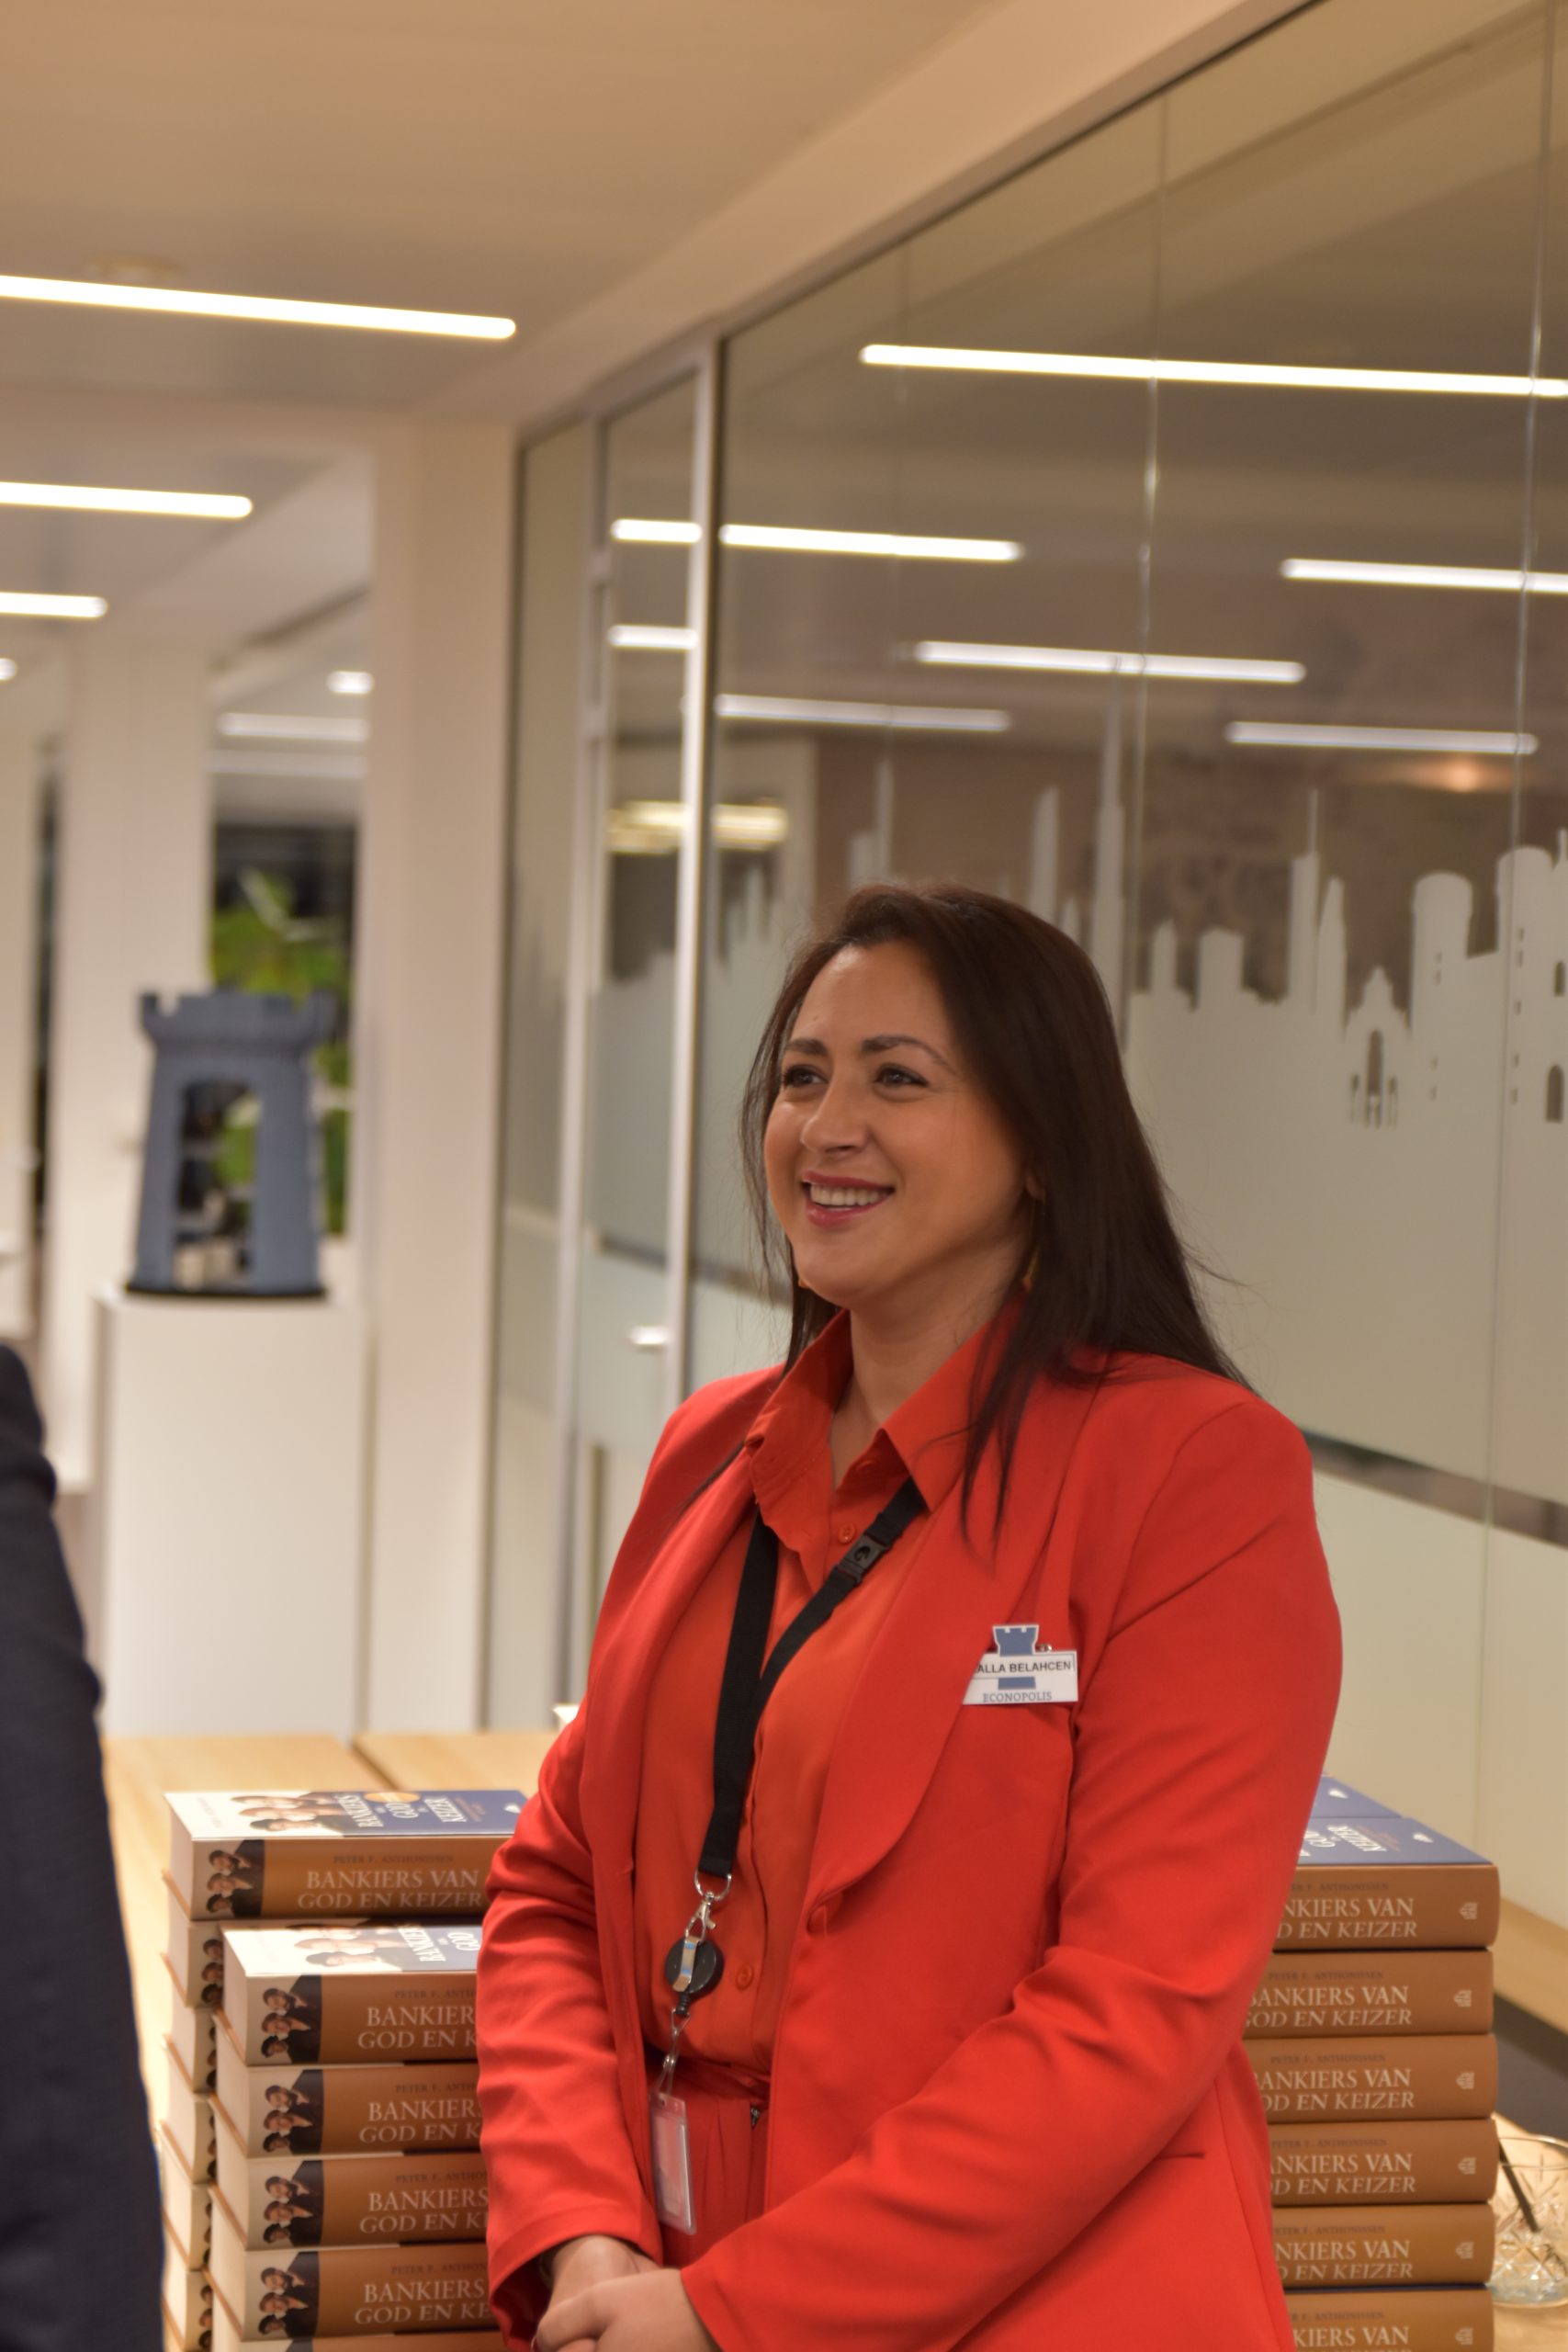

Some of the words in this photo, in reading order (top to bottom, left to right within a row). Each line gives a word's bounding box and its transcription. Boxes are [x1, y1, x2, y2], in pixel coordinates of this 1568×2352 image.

[1009, 1661, 1071, 1673] BELAHCEN
[983, 1691, 1052, 1702] ECONOPOLIS
[307, 1870, 423, 1890] BANKIERS
[430, 1869, 480, 1888] VAN
[298, 1893, 352, 1910] GOD
[359, 1893, 392, 1909] EN
[399, 1892, 483, 1908] KEIZER
[1283, 1898, 1360, 1917] NKIERS
[1367, 1898, 1415, 1917] VAN
[1298, 1922, 1332, 1939] EN
[1337, 1921, 1418, 1939] KEIZER
[1361, 1984, 1409, 2005] VAN
[367, 2006, 476, 2027] BANKIER
[1293, 2010, 1326, 2028] EN
[1333, 2008, 1413, 2027] KEIZER
[357, 2030, 414, 2050] GOD
[423, 2030, 457, 2048] EN
[1364, 2068, 1412, 2087] VAN
[1262, 2094, 1290, 2111] OD
[1296, 2094, 1328, 2111] EN
[1335, 2092, 1415, 2110] KEIZER
[358, 2125, 416, 2144] GOD
[423, 2123, 458, 2142] EN
[1270, 2154, 1359, 2175] NKIERS
[1365, 2153, 1413, 2173] VAN
[1297, 2178, 1330, 2195] EN
[1335, 2177, 1416, 2195] KEIZER
[368, 2188, 489, 2211] BANKIERS
[359, 2215, 416, 2234] GOD
[423, 2213, 458, 2232] EN
[1274, 2241, 1357, 2261] NKIERS
[1363, 2240, 1411, 2259] VAN
[1294, 2265, 1327, 2281] EN
[1333, 2263, 1414, 2280] KEIZER
[363, 2278, 485, 2303] BANKIERS
[355, 2307, 412, 2324] GOD
[419, 2304, 454, 2322] EN
[1293, 2327, 1356, 2348] KIERS
[1361, 2326, 1410, 2346] VAN
